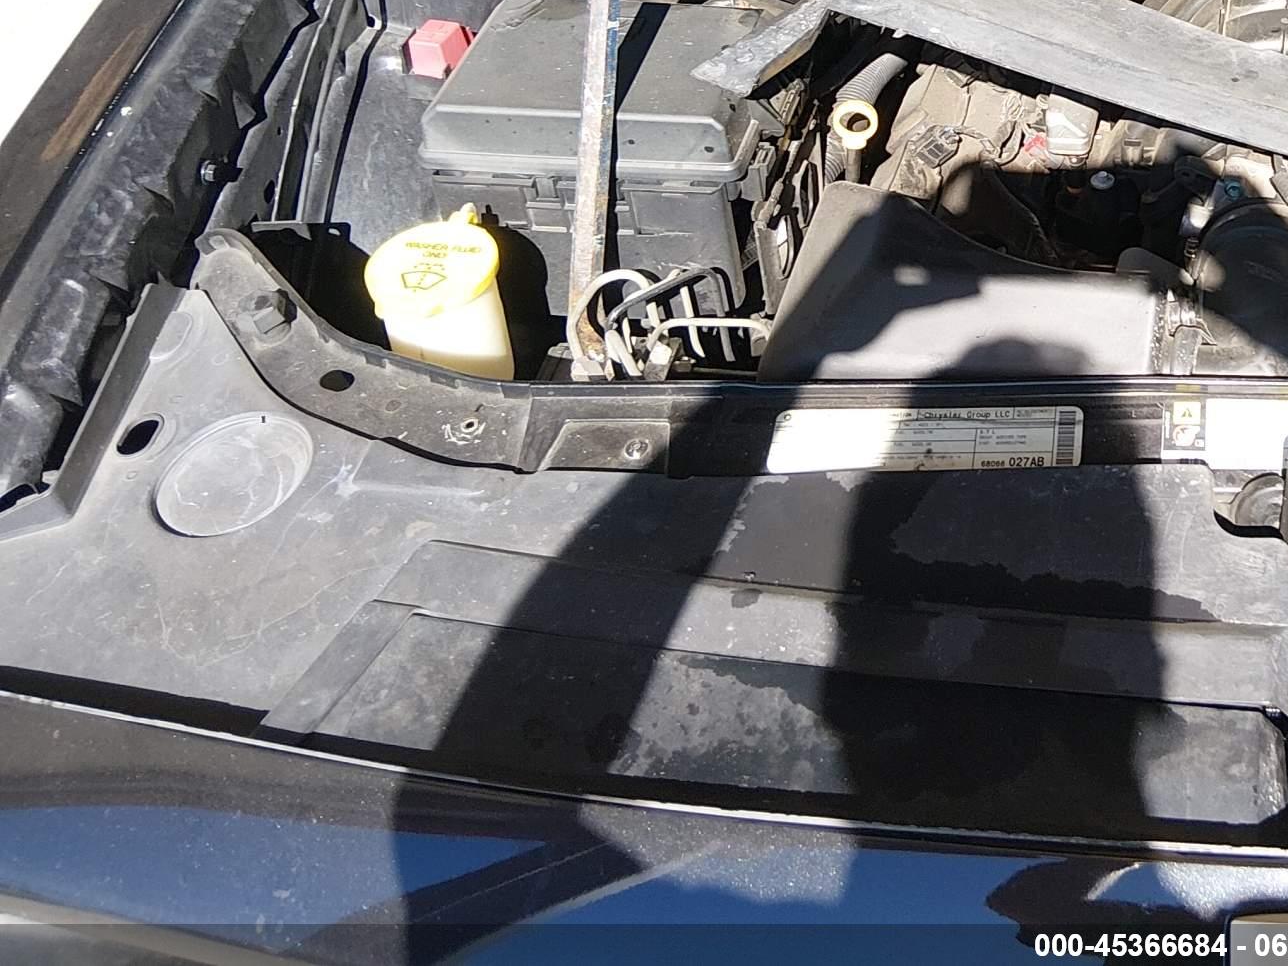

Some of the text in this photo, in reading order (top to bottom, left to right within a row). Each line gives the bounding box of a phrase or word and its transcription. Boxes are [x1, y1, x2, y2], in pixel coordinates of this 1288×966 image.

[924, 410, 962, 419] Chrysler
[966, 410, 991, 419] Group
[994, 409, 1011, 419] LLC
[1008, 456, 1045, 467] 027AB
